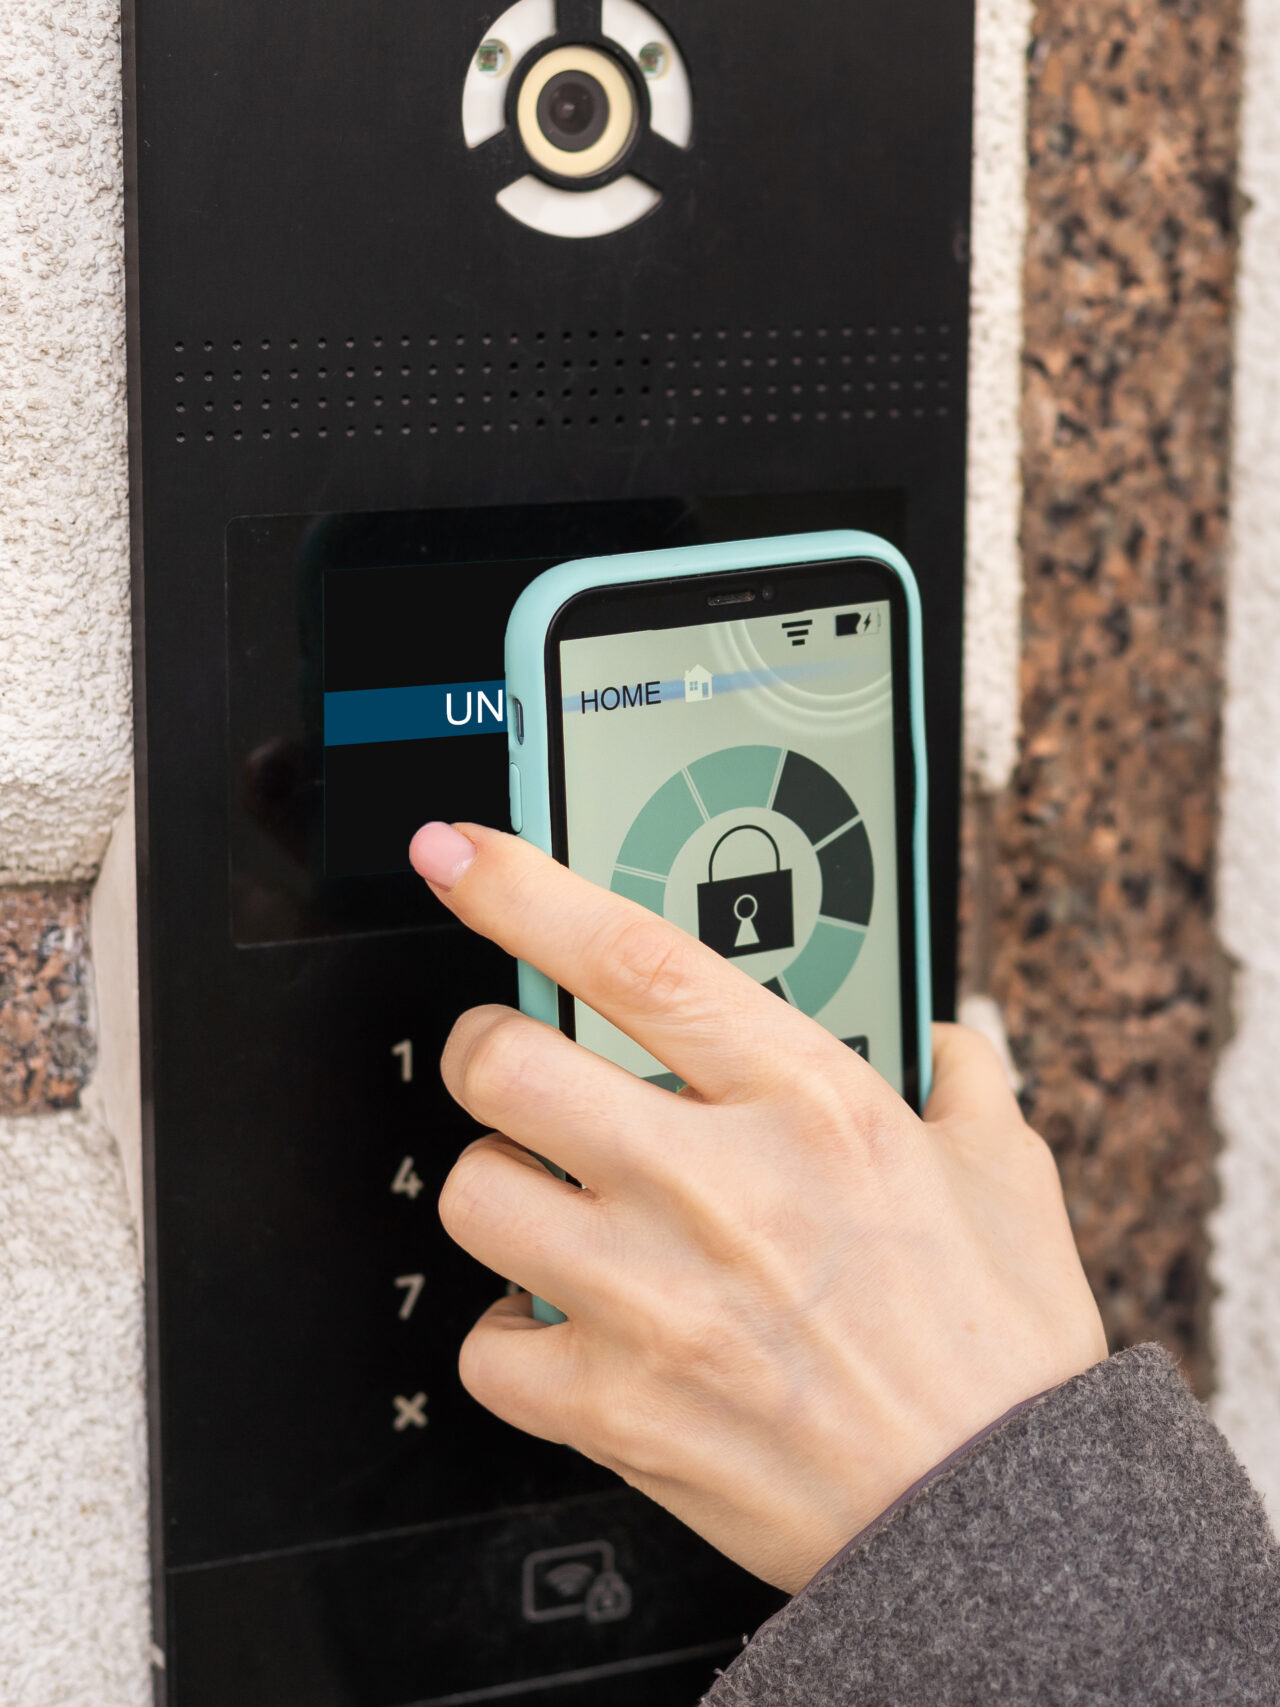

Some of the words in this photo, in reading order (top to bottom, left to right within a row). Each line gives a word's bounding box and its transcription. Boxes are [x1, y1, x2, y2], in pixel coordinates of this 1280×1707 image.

[581, 681, 661, 714] HOME
[392, 1040, 413, 1082] 1
[392, 1157, 423, 1199] 4
[395, 1274, 425, 1319] 7
